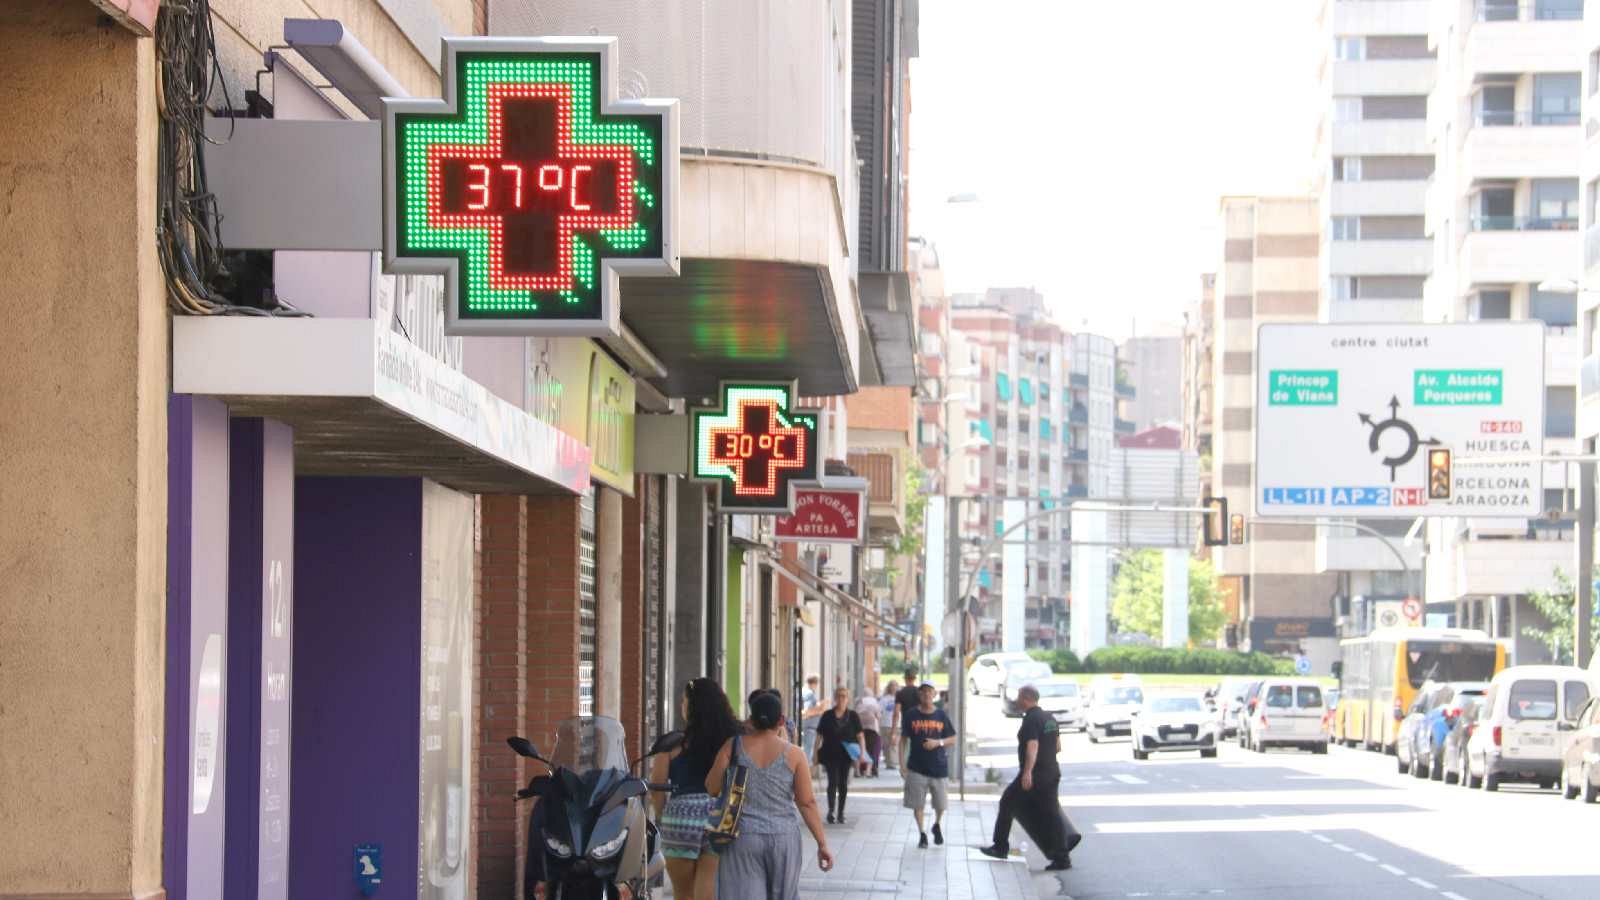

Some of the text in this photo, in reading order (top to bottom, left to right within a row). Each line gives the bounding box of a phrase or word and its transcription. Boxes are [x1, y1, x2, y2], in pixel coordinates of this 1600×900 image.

[1330, 335, 1429, 347] centre ciutat
[1418, 374, 1440, 386] Av.
[1272, 389, 1334, 402] de Viana
[1466, 440, 1531, 452] HUESCA
[1455, 477, 1530, 489] RCELONA
[1268, 488, 1321, 504] LL-11
[1335, 488, 1389, 505] AP-2
[1446, 495, 1530, 505] ARAGOZA
[810, 512, 823, 522] PA
[819, 494, 857, 529] FORNER
